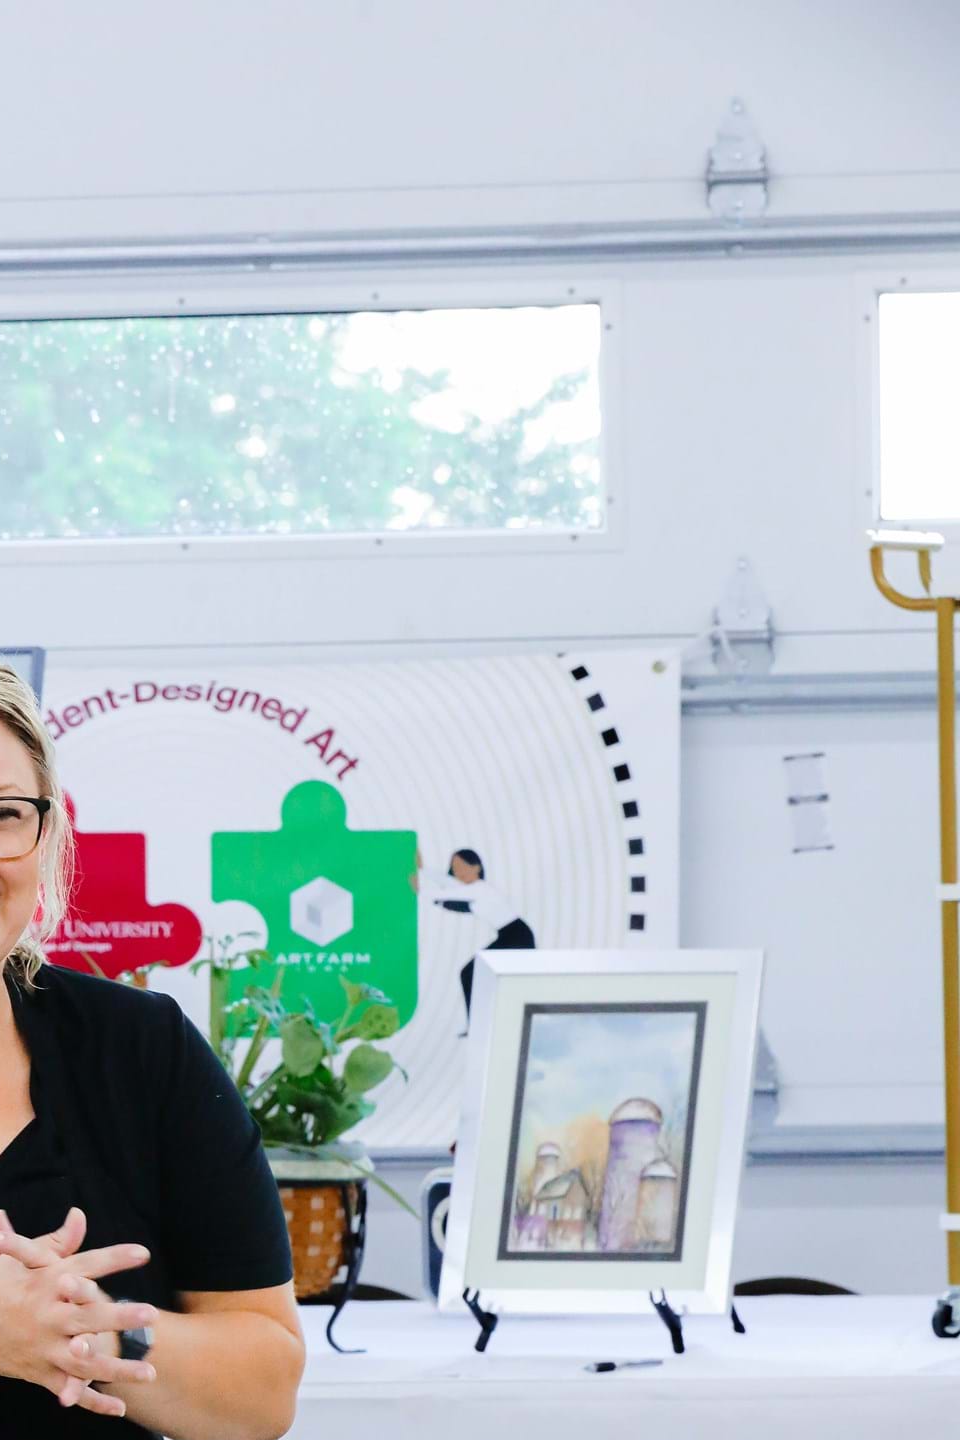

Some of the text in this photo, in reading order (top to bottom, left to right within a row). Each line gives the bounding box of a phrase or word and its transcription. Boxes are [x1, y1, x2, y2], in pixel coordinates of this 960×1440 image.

[44, 681, 360, 779] dent-Designed Art
[63, 919, 174, 938] UNIVERSITY
[275, 953, 371, 965] ART FARM
